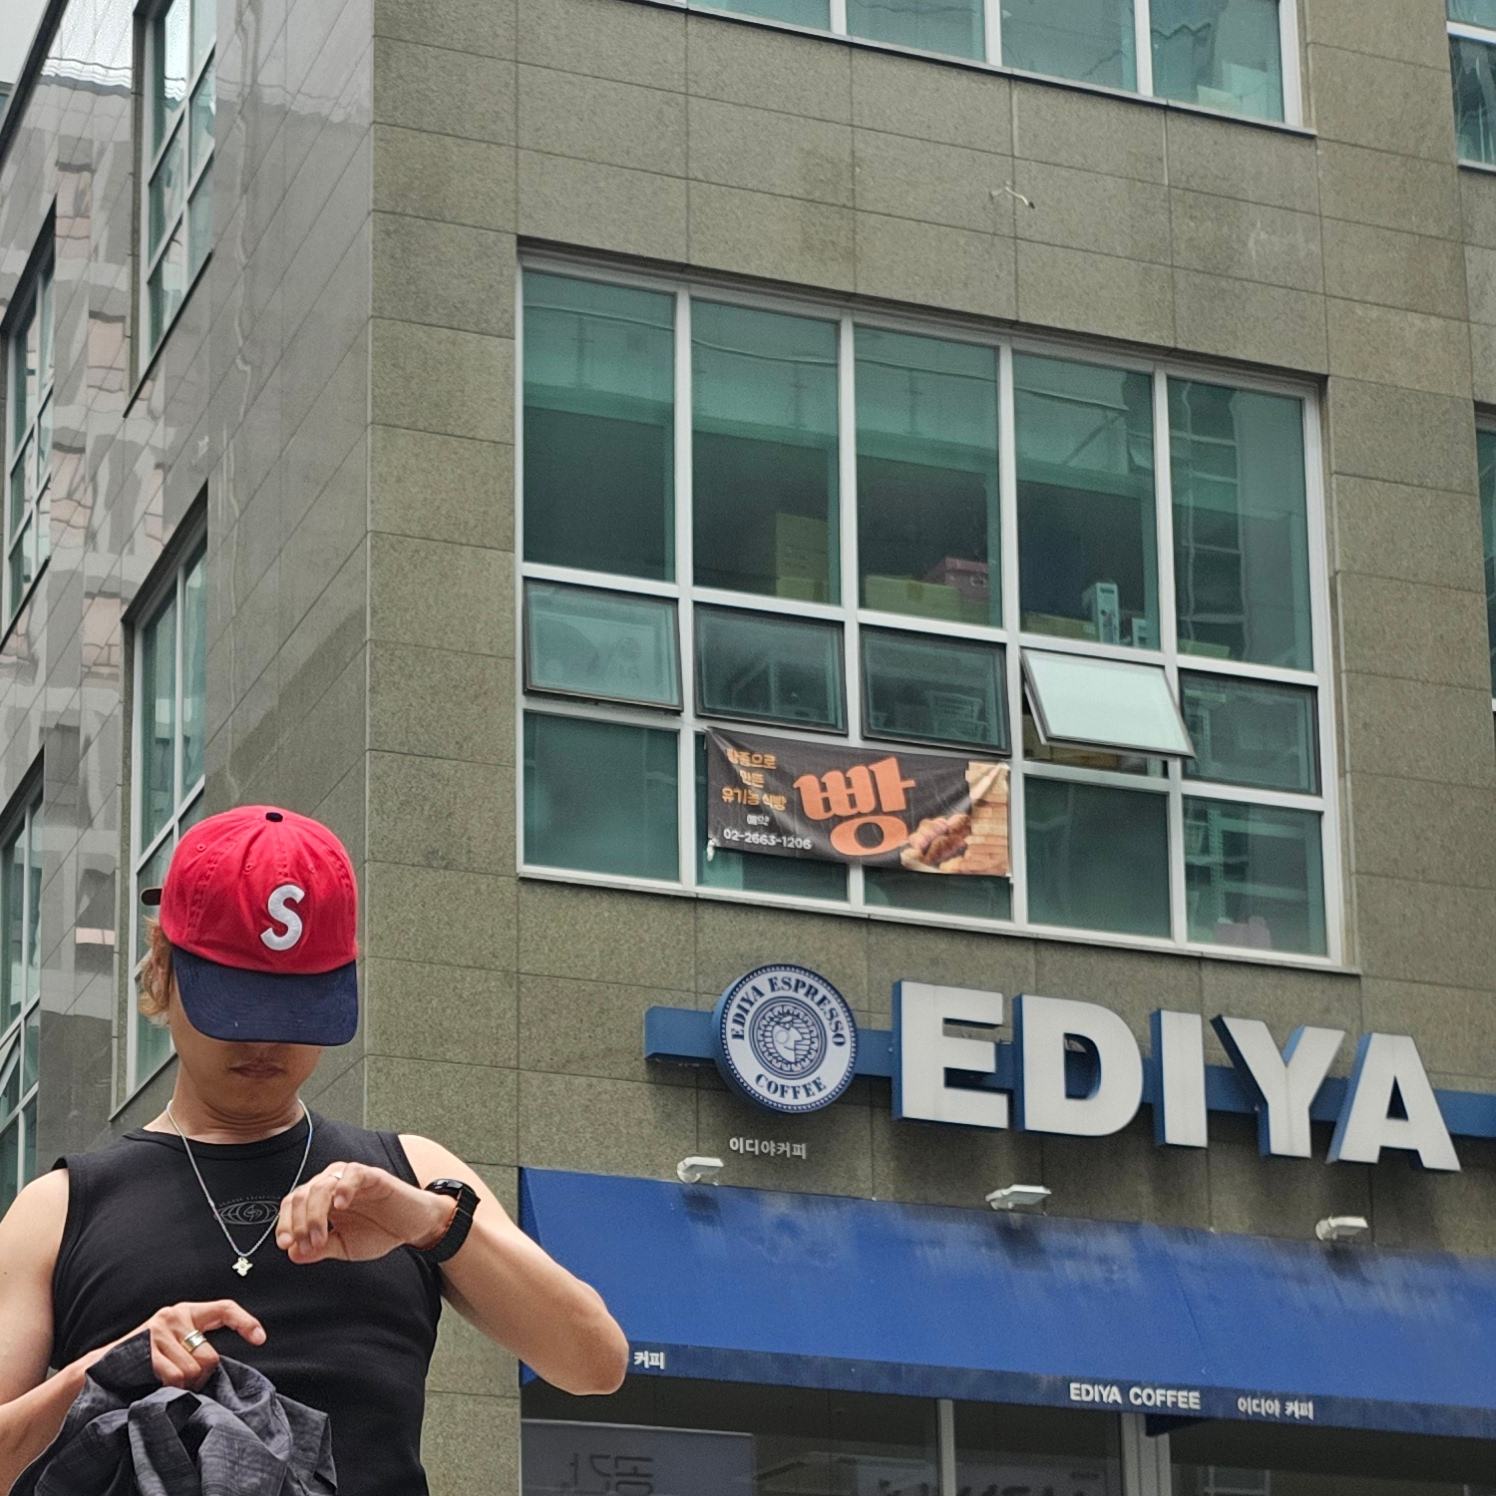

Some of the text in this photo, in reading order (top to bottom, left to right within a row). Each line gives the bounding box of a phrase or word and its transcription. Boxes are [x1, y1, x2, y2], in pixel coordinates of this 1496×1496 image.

[721, 786, 760, 805] 유기농
[793, 756, 916, 856] 빵
[723, 828, 812, 850] 02-2663-1206
[260, 884, 305, 951] S
[731, 976, 847, 1047] EDIYA ESPRESSO
[755, 1073, 827, 1100] COFFEE
[894, 979, 1461, 1172] EDIYA
[729, 1136, 808, 1160] 이디야커피
[633, 1350, 666, 1370] 커피
[1069, 1382, 1315, 1421] EDIYA COFFEE 이디야 커피
